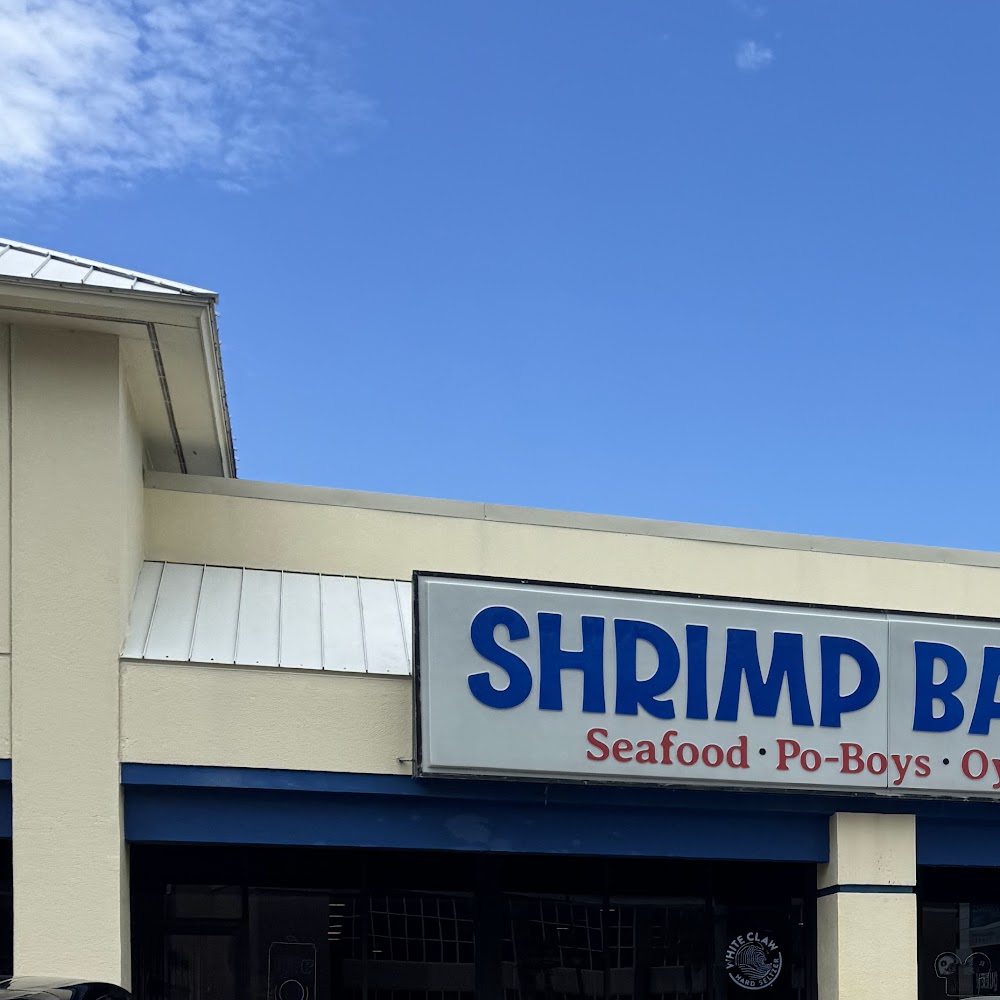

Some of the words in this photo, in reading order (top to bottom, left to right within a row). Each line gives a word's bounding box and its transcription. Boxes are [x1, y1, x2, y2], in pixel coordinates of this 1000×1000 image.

[467, 606, 880, 728] SHRIMP
[586, 728, 749, 769] Seafood
[776, 739, 931, 787] Po-Boys
[725, 935, 745, 969] WHITE
[746, 932, 778, 950] CLAW
[735, 974, 755, 986] HARD
[758, 958, 780, 986] SELTZER
